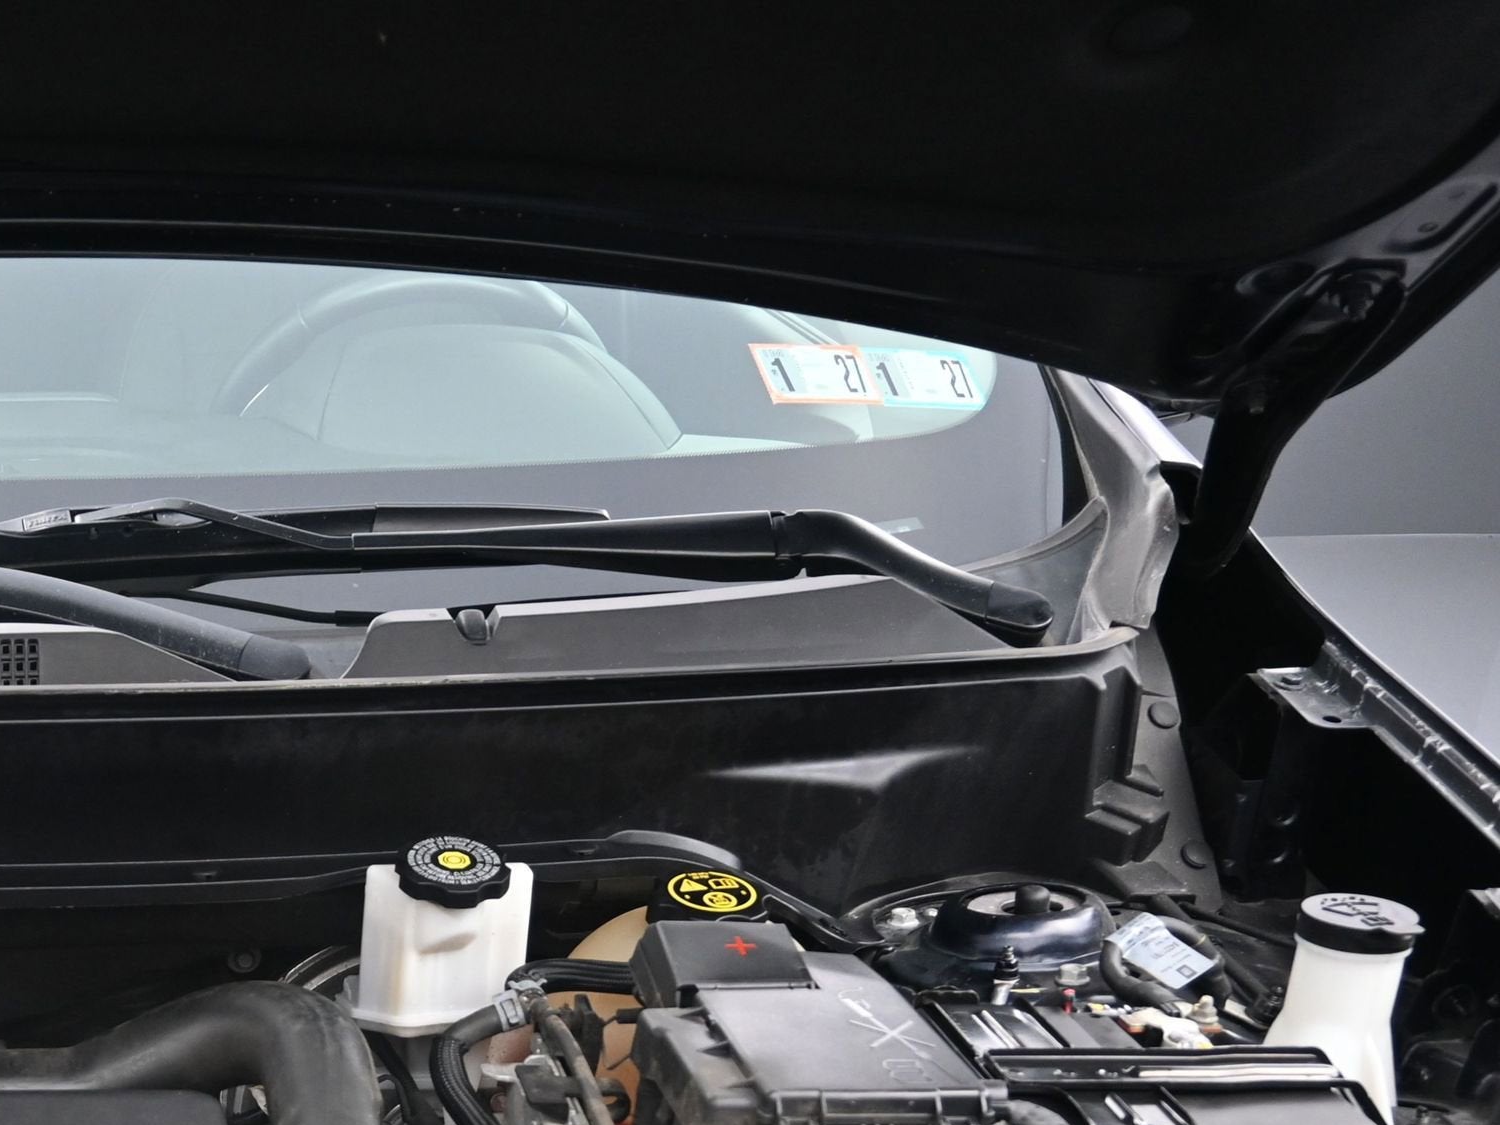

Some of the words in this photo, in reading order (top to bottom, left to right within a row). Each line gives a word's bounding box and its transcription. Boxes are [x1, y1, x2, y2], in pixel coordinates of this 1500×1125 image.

[771, 357, 795, 392] 1
[834, 354, 867, 393] 27
[875, 362, 899, 396] 1
[940, 359, 973, 399] 27
